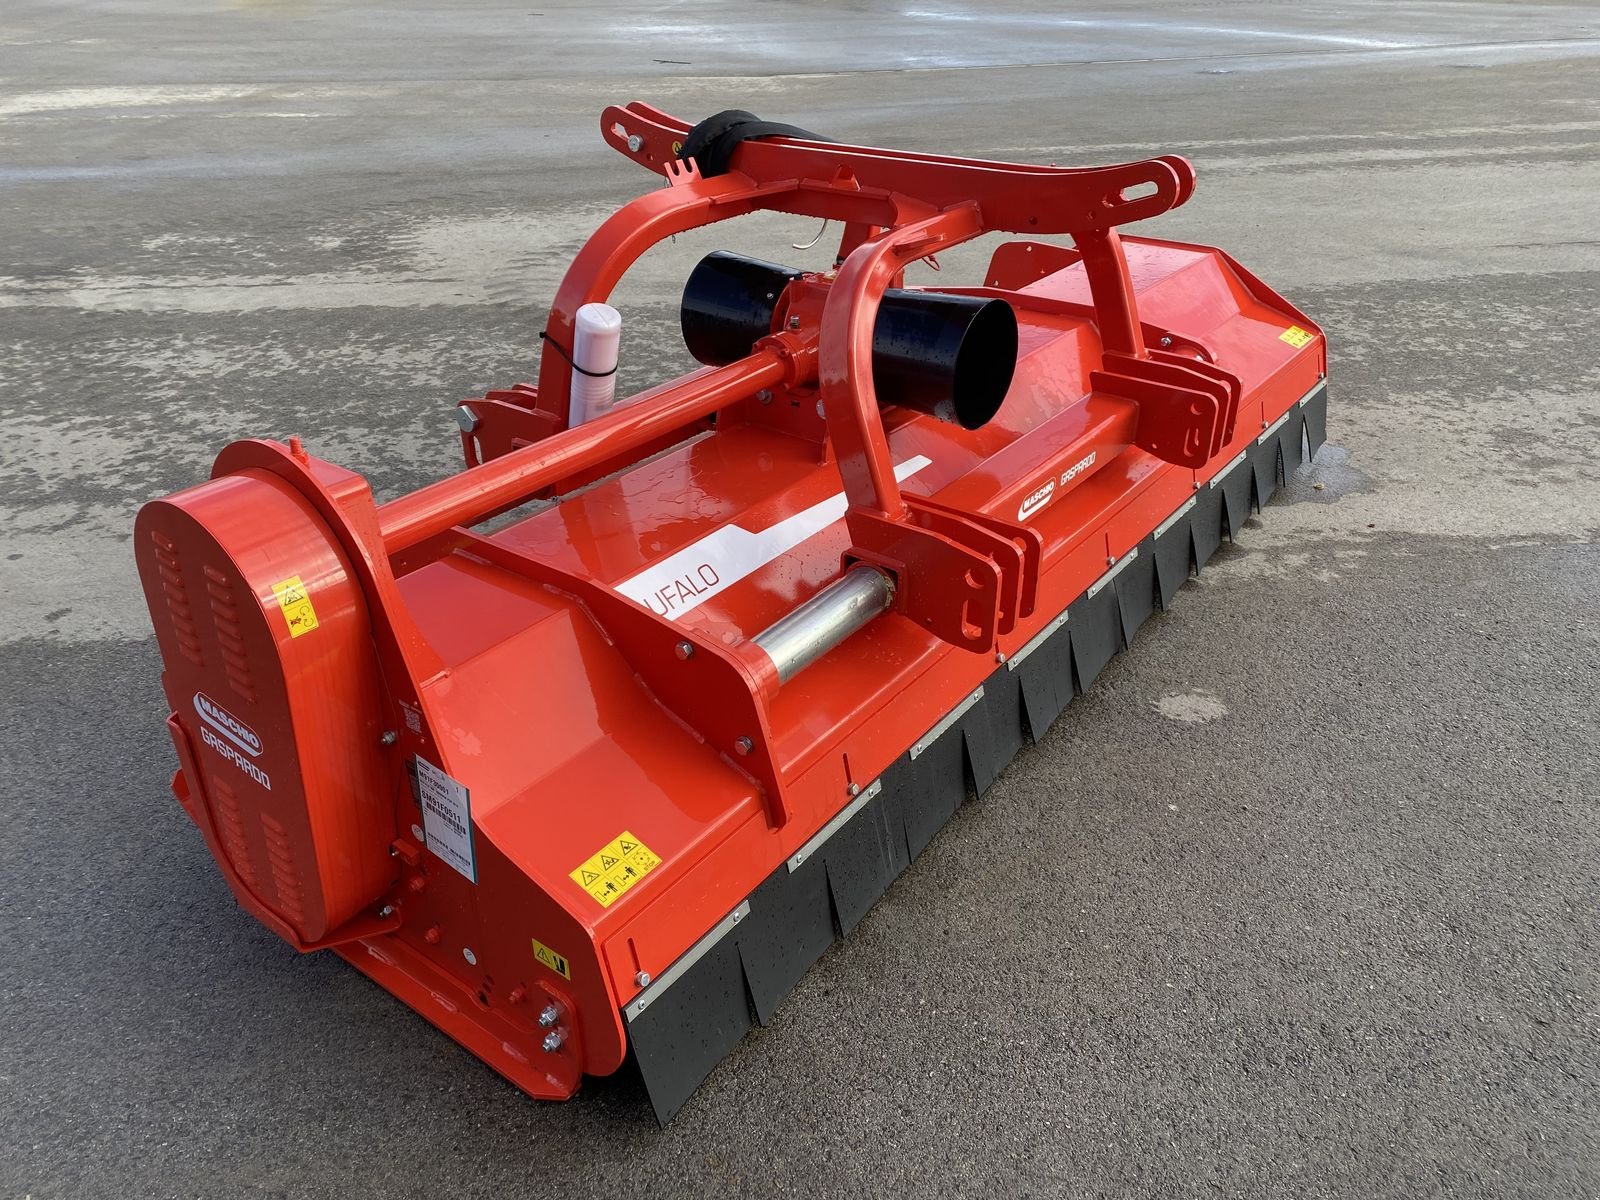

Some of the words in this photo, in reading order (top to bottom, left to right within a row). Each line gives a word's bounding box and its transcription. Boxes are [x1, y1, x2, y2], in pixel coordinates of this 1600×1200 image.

[1023, 481, 1055, 511] MASCHIO
[1060, 451, 1096, 486] GASPARDO
[643, 563, 719, 616] UFALO
[200, 696, 260, 748] MASCHIO
[200, 726, 271, 791] GASPARDO
